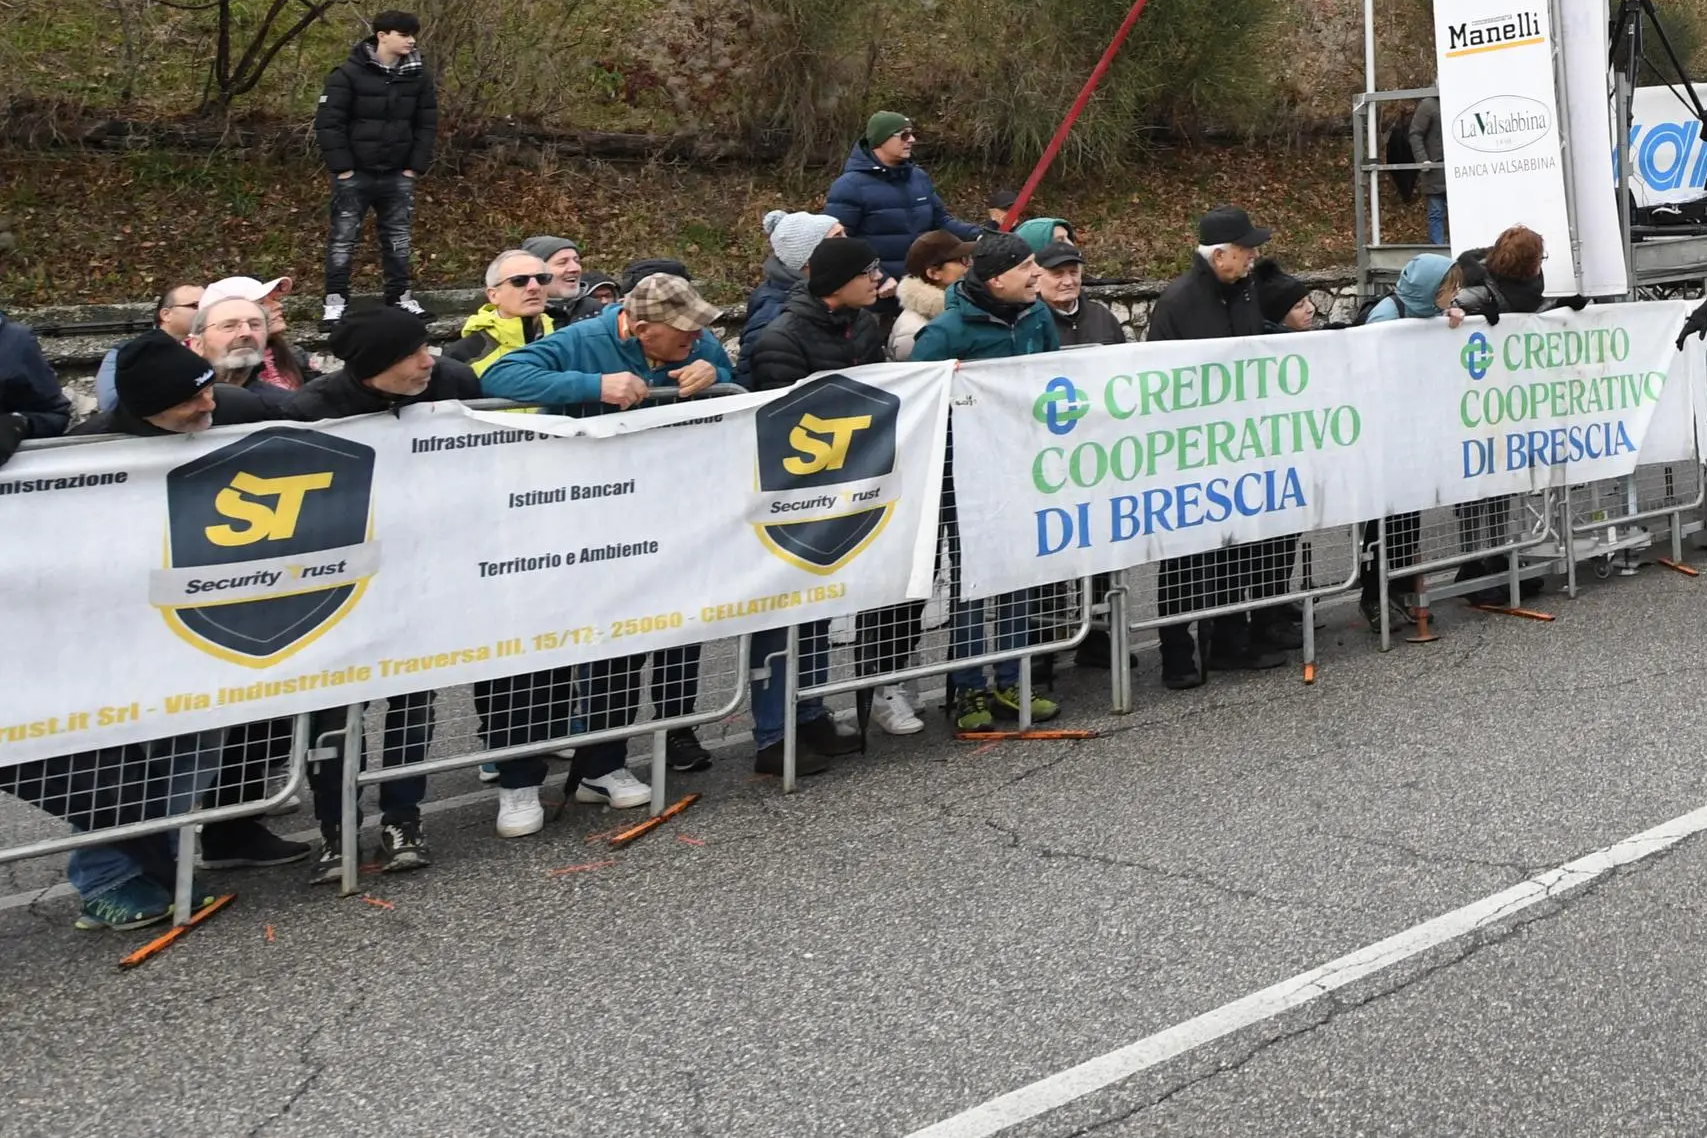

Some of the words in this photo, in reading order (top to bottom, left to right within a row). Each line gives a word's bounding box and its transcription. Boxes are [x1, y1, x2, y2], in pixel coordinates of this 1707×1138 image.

[1448, 12, 1540, 49] Manelli
[1454, 163, 1489, 179] BANCA
[1491, 156, 1556, 175] VALSABBINA
[1503, 327, 1630, 372] CREDITO
[1104, 354, 1310, 420] CREDITO
[1460, 371, 1667, 428] COOPERATIVO
[411, 429, 535, 454] Infrastrutture
[782, 413, 872, 475] ST
[1032, 405, 1361, 494] COOPERATIVO
[1461, 438, 1495, 479] DI
[1505, 420, 1636, 473] BRESCIA
[205, 471, 334, 547] ST
[508, 486, 567, 508] Istituti
[571, 479, 636, 501] Bancari
[770, 495, 837, 514] Security
[1034, 502, 1091, 557] DI
[1109, 467, 1307, 543] BRESCIA
[185, 570, 283, 595] Security
[478, 550, 561, 577] Territorio
[566, 552, 576, 565] e
[580, 539, 659, 564] Ambiente
[97, 702, 139, 726] Srl
[164, 692, 210, 714] Via
[217, 664, 371, 705] Industriale
[379, 645, 491, 678] Traversa
[701, 590, 802, 623] CELLATICA
